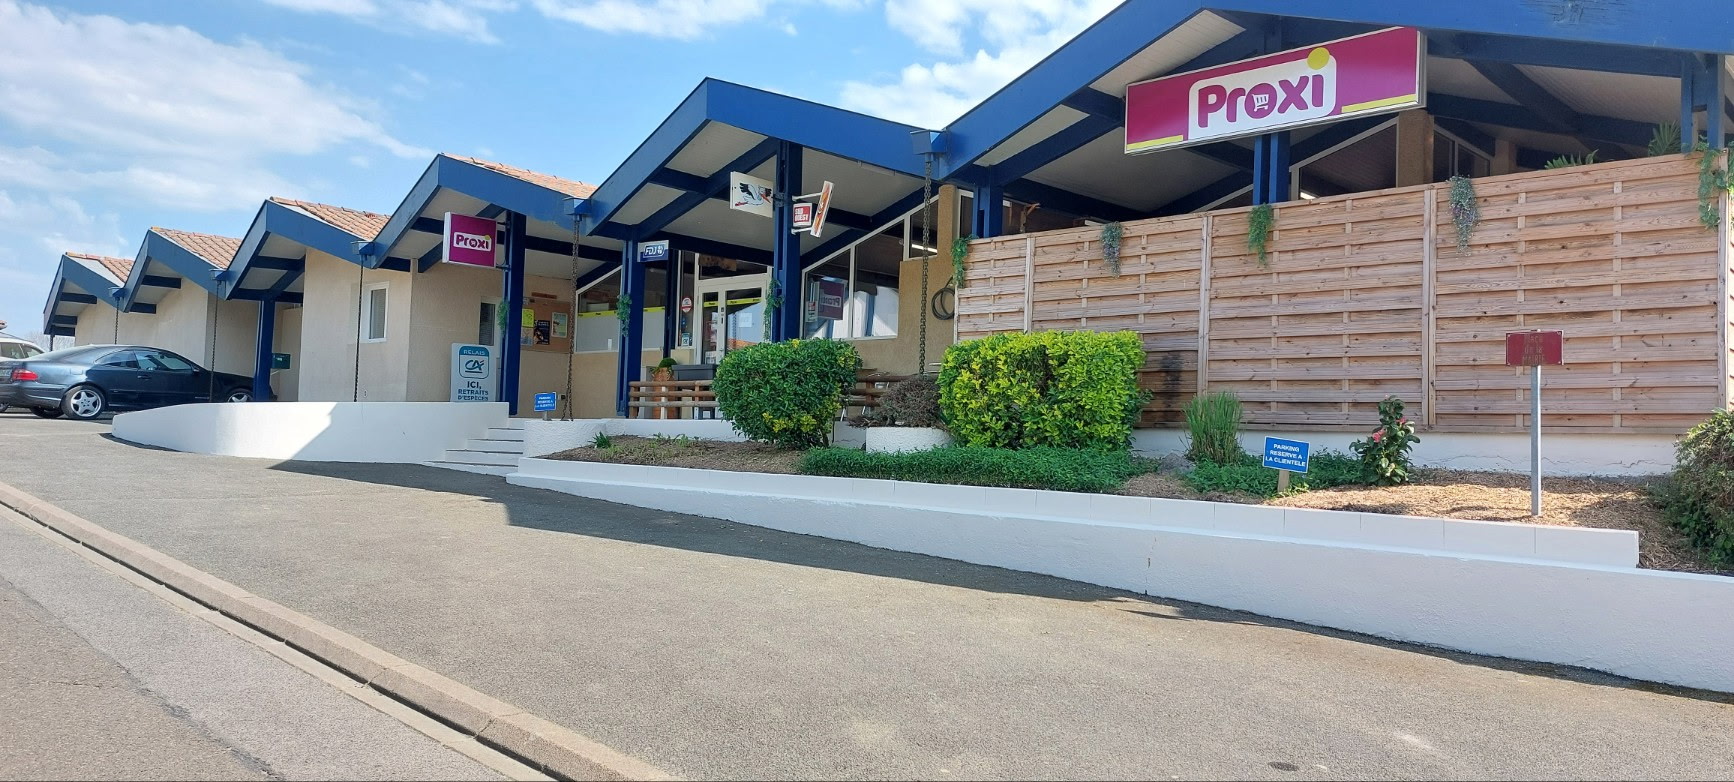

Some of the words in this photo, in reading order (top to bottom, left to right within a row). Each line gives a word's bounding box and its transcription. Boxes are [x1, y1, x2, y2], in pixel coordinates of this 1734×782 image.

[1197, 74, 1325, 129] Proxi
[456, 234, 489, 250] Proxi
[645, 247, 657, 256] FDJ
[467, 381, 482, 390] ICI,
[458, 388, 489, 396] RETRAITS
[1273, 443, 1300, 453] PARKING
